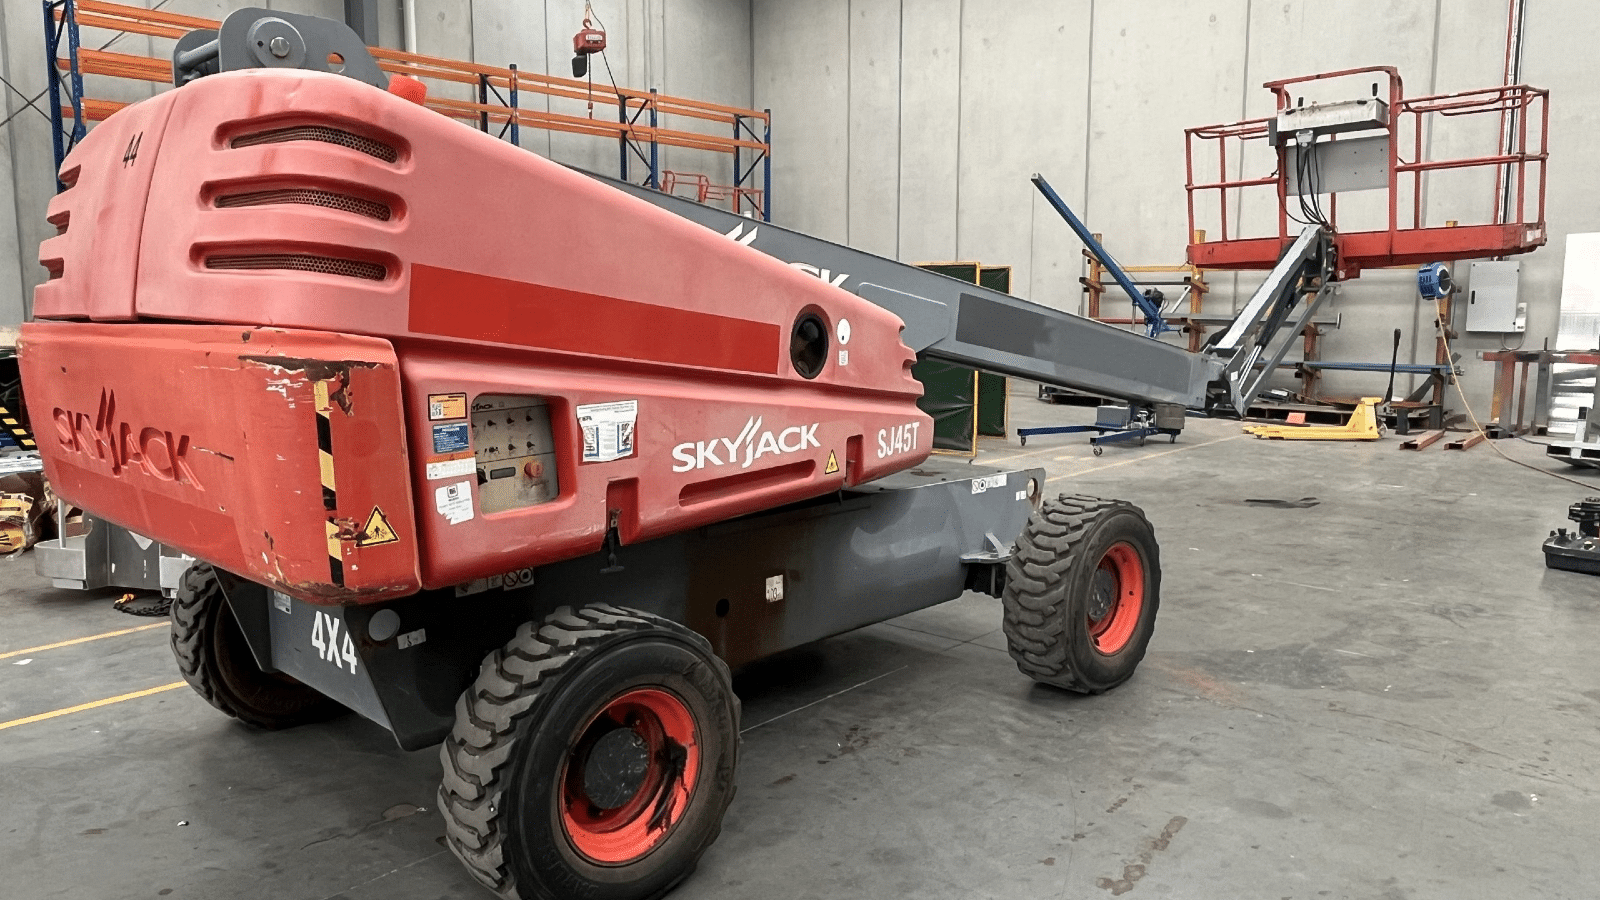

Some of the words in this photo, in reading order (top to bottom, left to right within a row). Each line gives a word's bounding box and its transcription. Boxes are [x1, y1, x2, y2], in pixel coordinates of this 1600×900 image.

[123, 131, 143, 169] 44
[53, 386, 205, 491] SKYJACK
[672, 415, 821, 472] SKYJACK
[877, 421, 920, 459] SJ45T
[311, 610, 358, 675] 4X4
